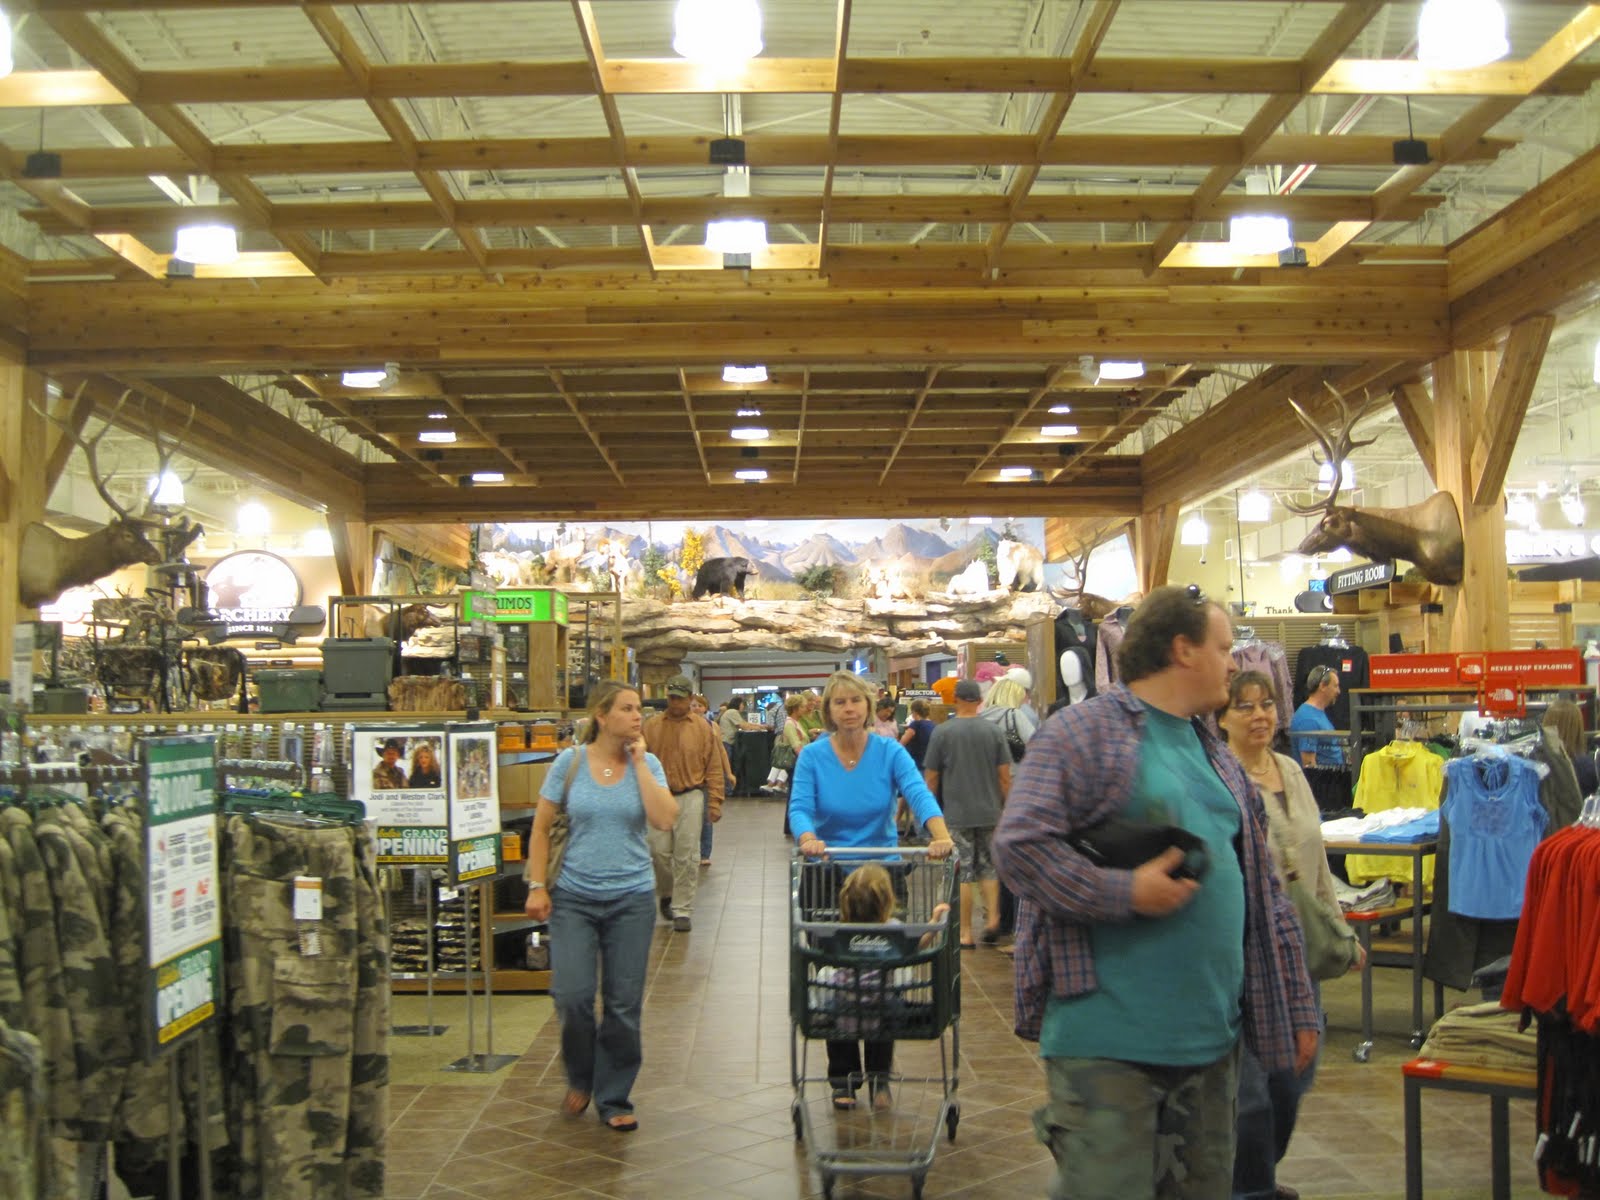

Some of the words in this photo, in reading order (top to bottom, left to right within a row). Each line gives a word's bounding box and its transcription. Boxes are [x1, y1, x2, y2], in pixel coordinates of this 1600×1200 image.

[1337, 570, 1363, 589] FITTING
[1364, 564, 1385, 582] ROOM
[493, 597, 532, 610] RIMOS
[207, 608, 294, 621] ARCHERY
[1264, 606, 1293, 615] Thank
[227, 624, 254, 634] SINCE
[256, 624, 273, 633] 1961
[1413, 666, 1449, 674] EXPLORING
[1534, 663, 1573, 671] EXPLORING
[403, 829, 448, 839] GRAND
